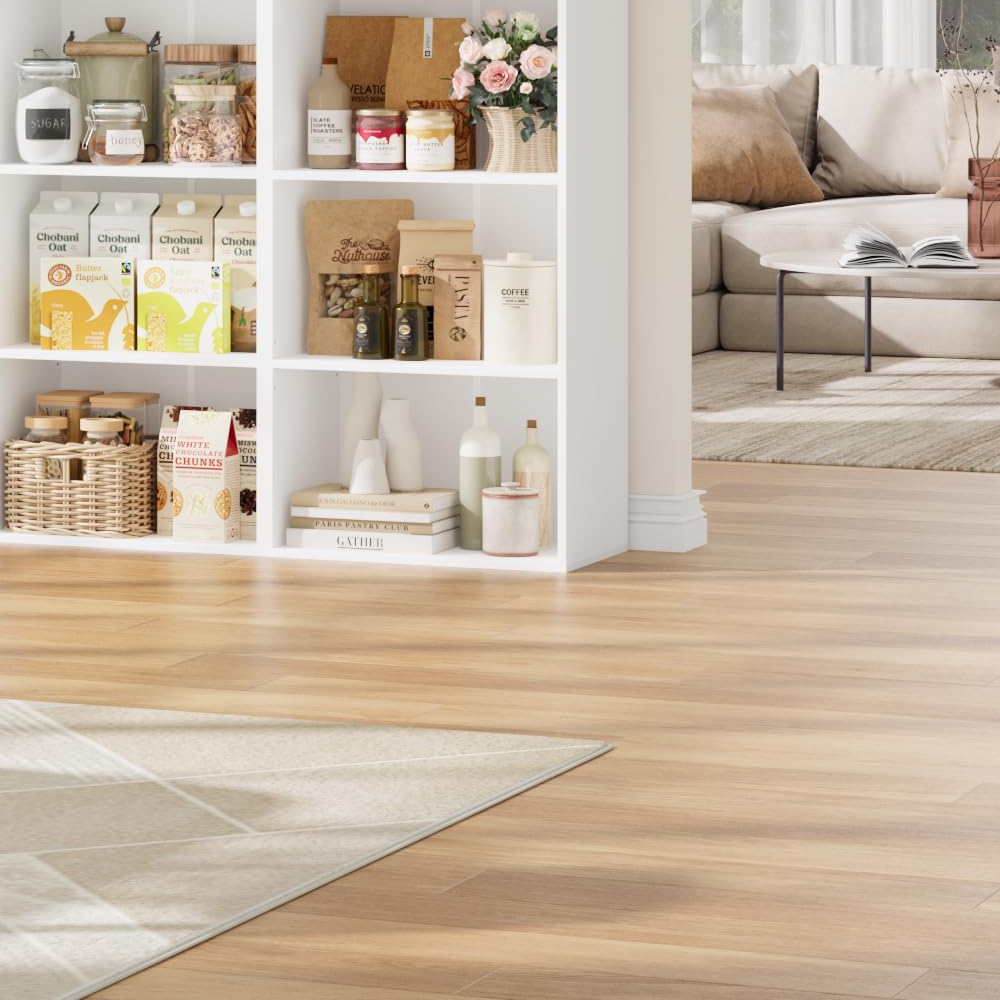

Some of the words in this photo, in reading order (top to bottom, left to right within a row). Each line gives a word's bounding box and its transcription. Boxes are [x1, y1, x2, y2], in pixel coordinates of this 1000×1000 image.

[30, 116, 66, 129] SUGAR
[110, 133, 144, 148] honey
[36, 232, 80, 243] Chobani
[97, 233, 141, 244] Chobani
[159, 234, 203, 245] Chobani
[48, 243, 67, 252] Oat
[109, 244, 128, 253] Oat
[341, 238, 361, 250] The
[171, 246, 190, 255] Oat
[234, 247, 253, 257] Oat
[331, 248, 392, 264] Nuthouse
[75, 264, 104, 272] Butter
[75, 273, 110, 283] flapjack
[501, 288, 530, 296] COFFEE
[454, 276, 471, 320] PASTA
[177, 441, 210, 449] WHITE
[175, 449, 223, 457] CHOCOLATE
[175, 457, 223, 467] CHUNKS
[315, 520, 342, 528] PARIS
[345, 521, 380, 530] PASTRY
[336, 535, 383, 548] GATHER
